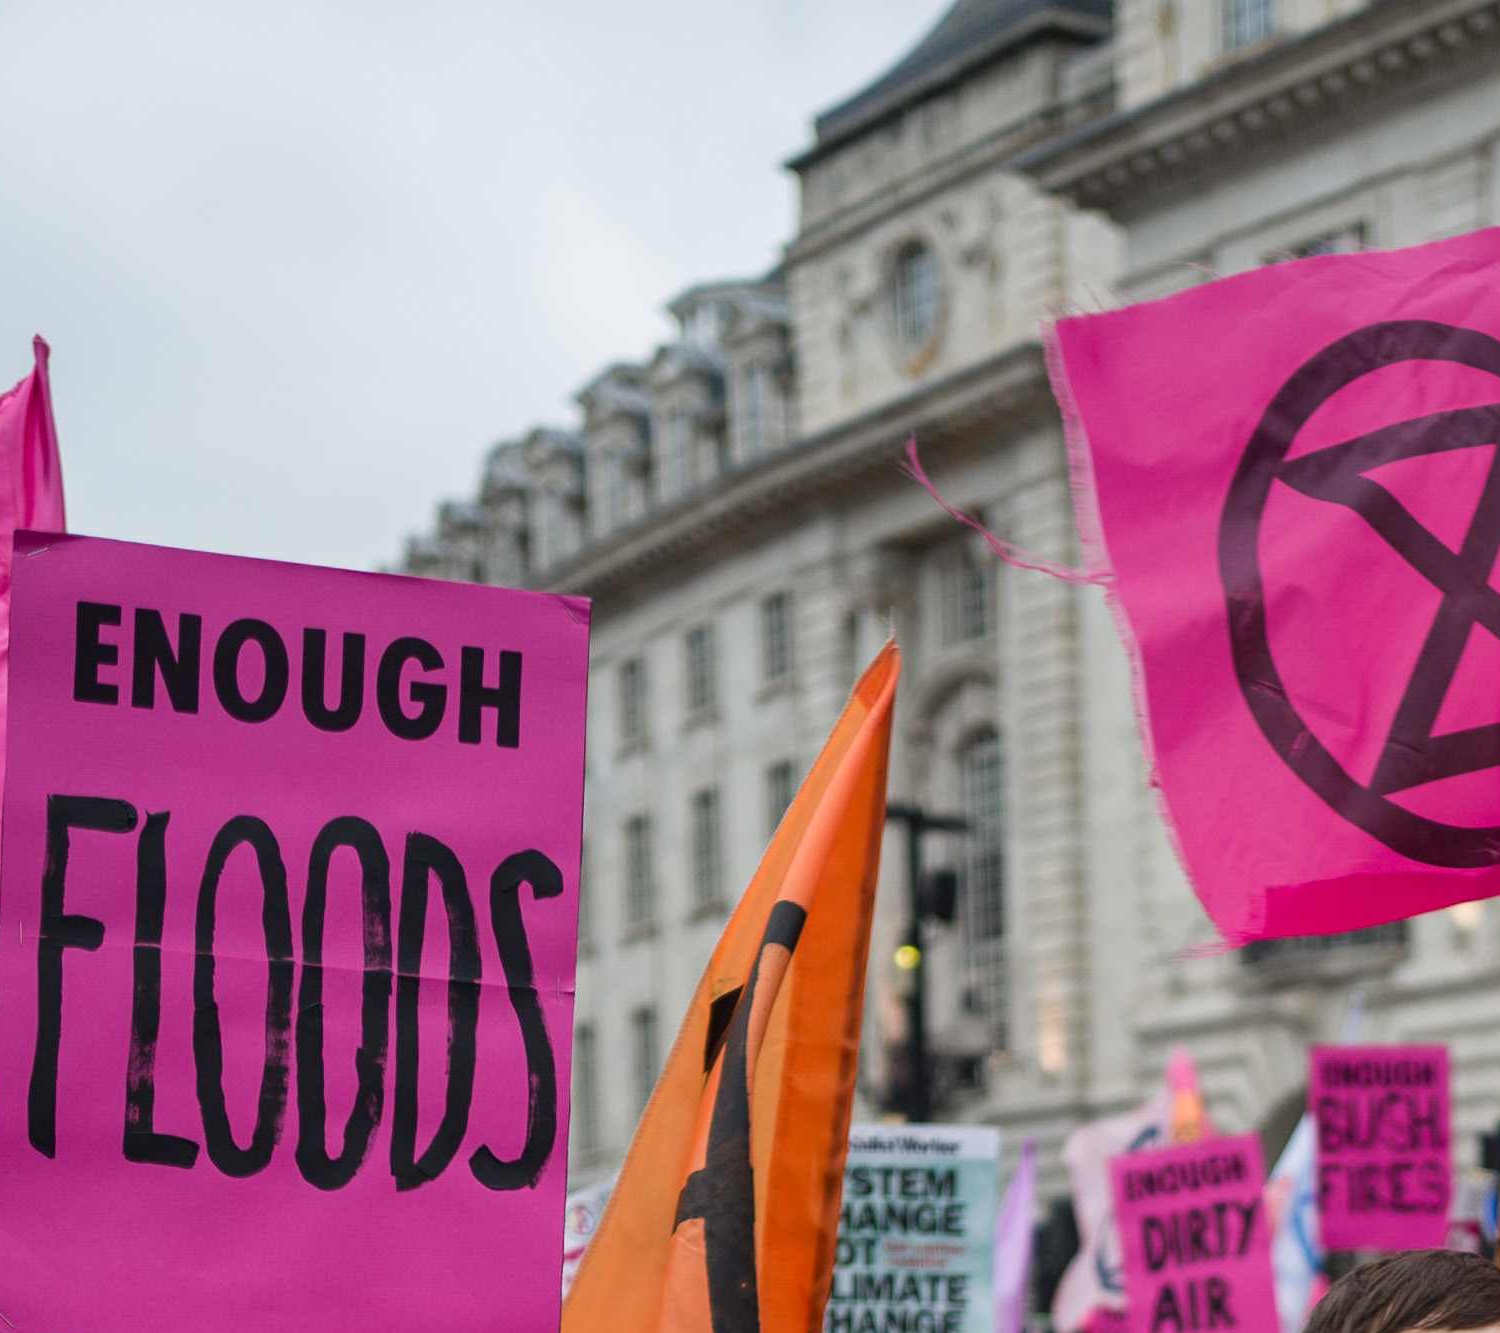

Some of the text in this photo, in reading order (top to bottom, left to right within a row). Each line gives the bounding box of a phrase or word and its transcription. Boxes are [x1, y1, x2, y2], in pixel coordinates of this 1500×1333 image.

[73, 600, 523, 748] ENOUGH
[27, 794, 564, 1192] FLOODS
[1321, 1060, 1436, 1087] ENOUGH
[1316, 1096, 1446, 1153] BUSH
[845, 1167, 958, 1198] STEM
[1123, 1153, 1246, 1201] ENOUGH
[1318, 1164, 1446, 1214] FIRES
[840, 1203, 966, 1236] HANGE
[1142, 1199, 1261, 1272] DIRTY
[835, 1237, 878, 1265] OT
[831, 1274, 967, 1304] LIMATE
